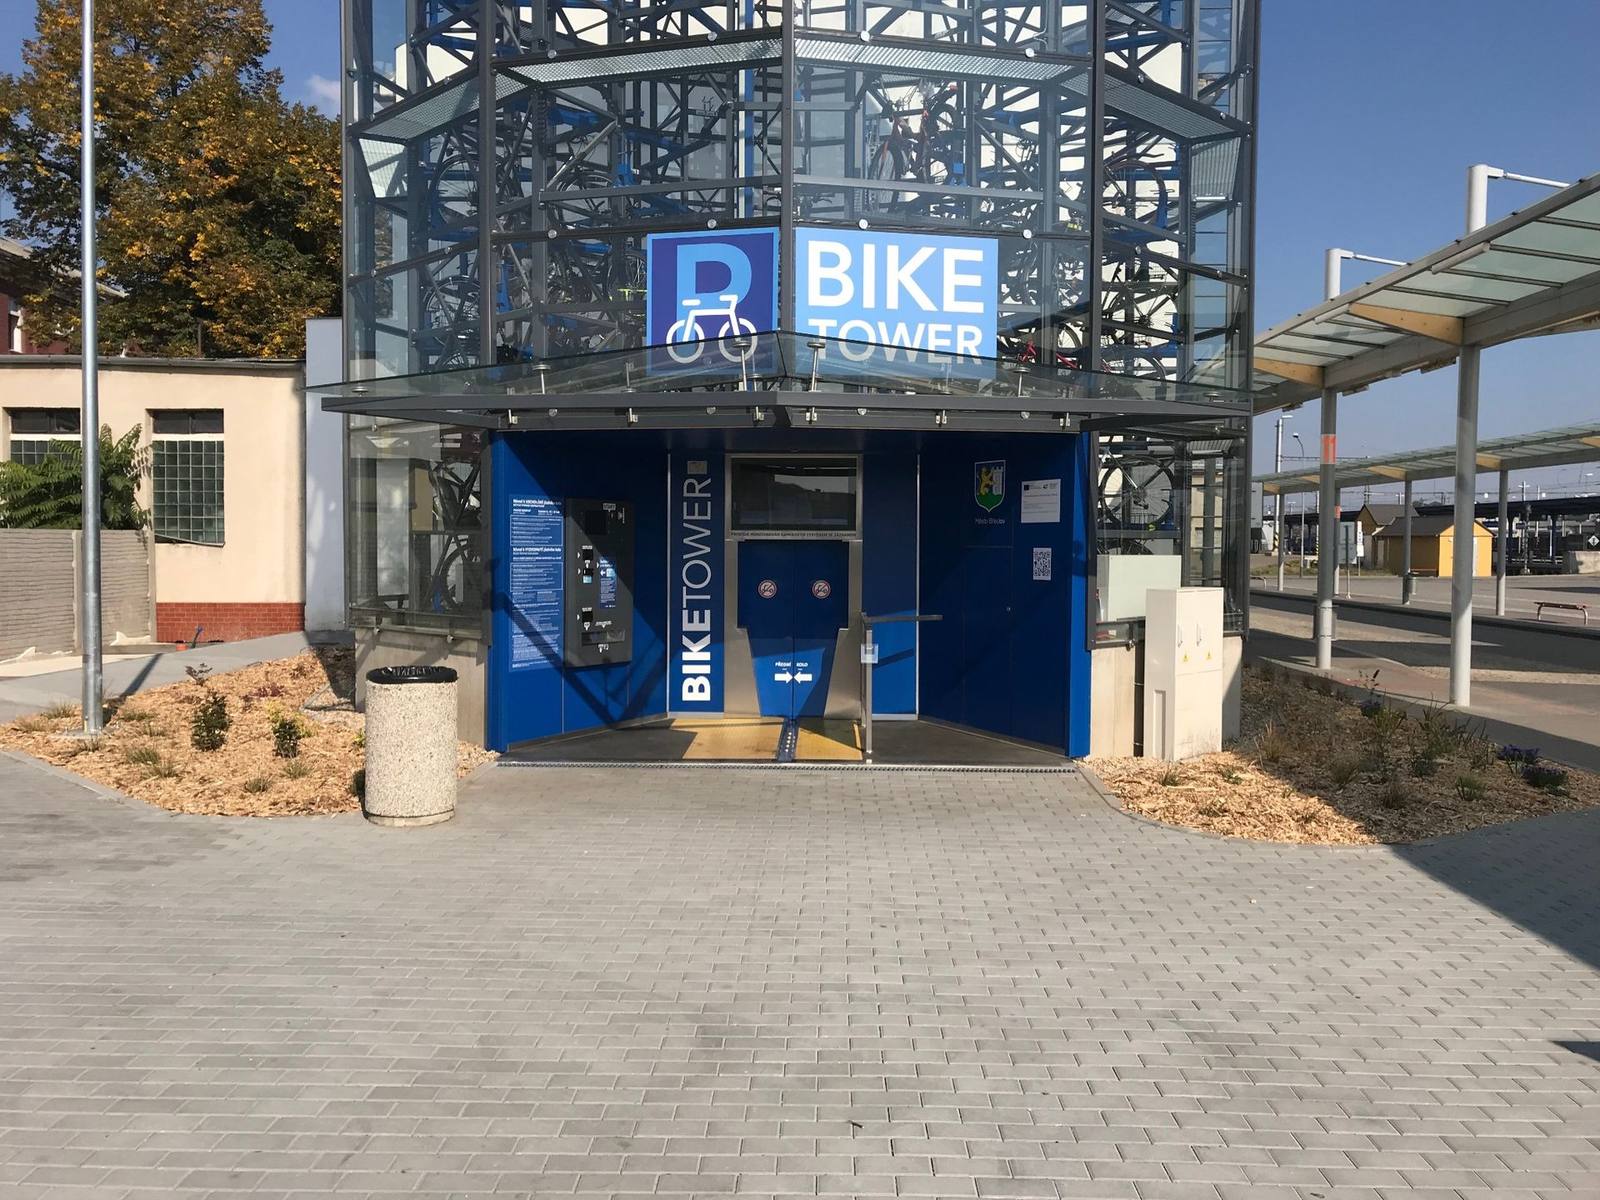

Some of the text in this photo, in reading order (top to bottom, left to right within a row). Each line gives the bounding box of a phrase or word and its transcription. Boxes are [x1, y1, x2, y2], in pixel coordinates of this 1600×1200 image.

[808, 240, 984, 313] BIKE
[808, 318, 983, 365] TOWER
[682, 477, 712, 701] BIKETOWER
